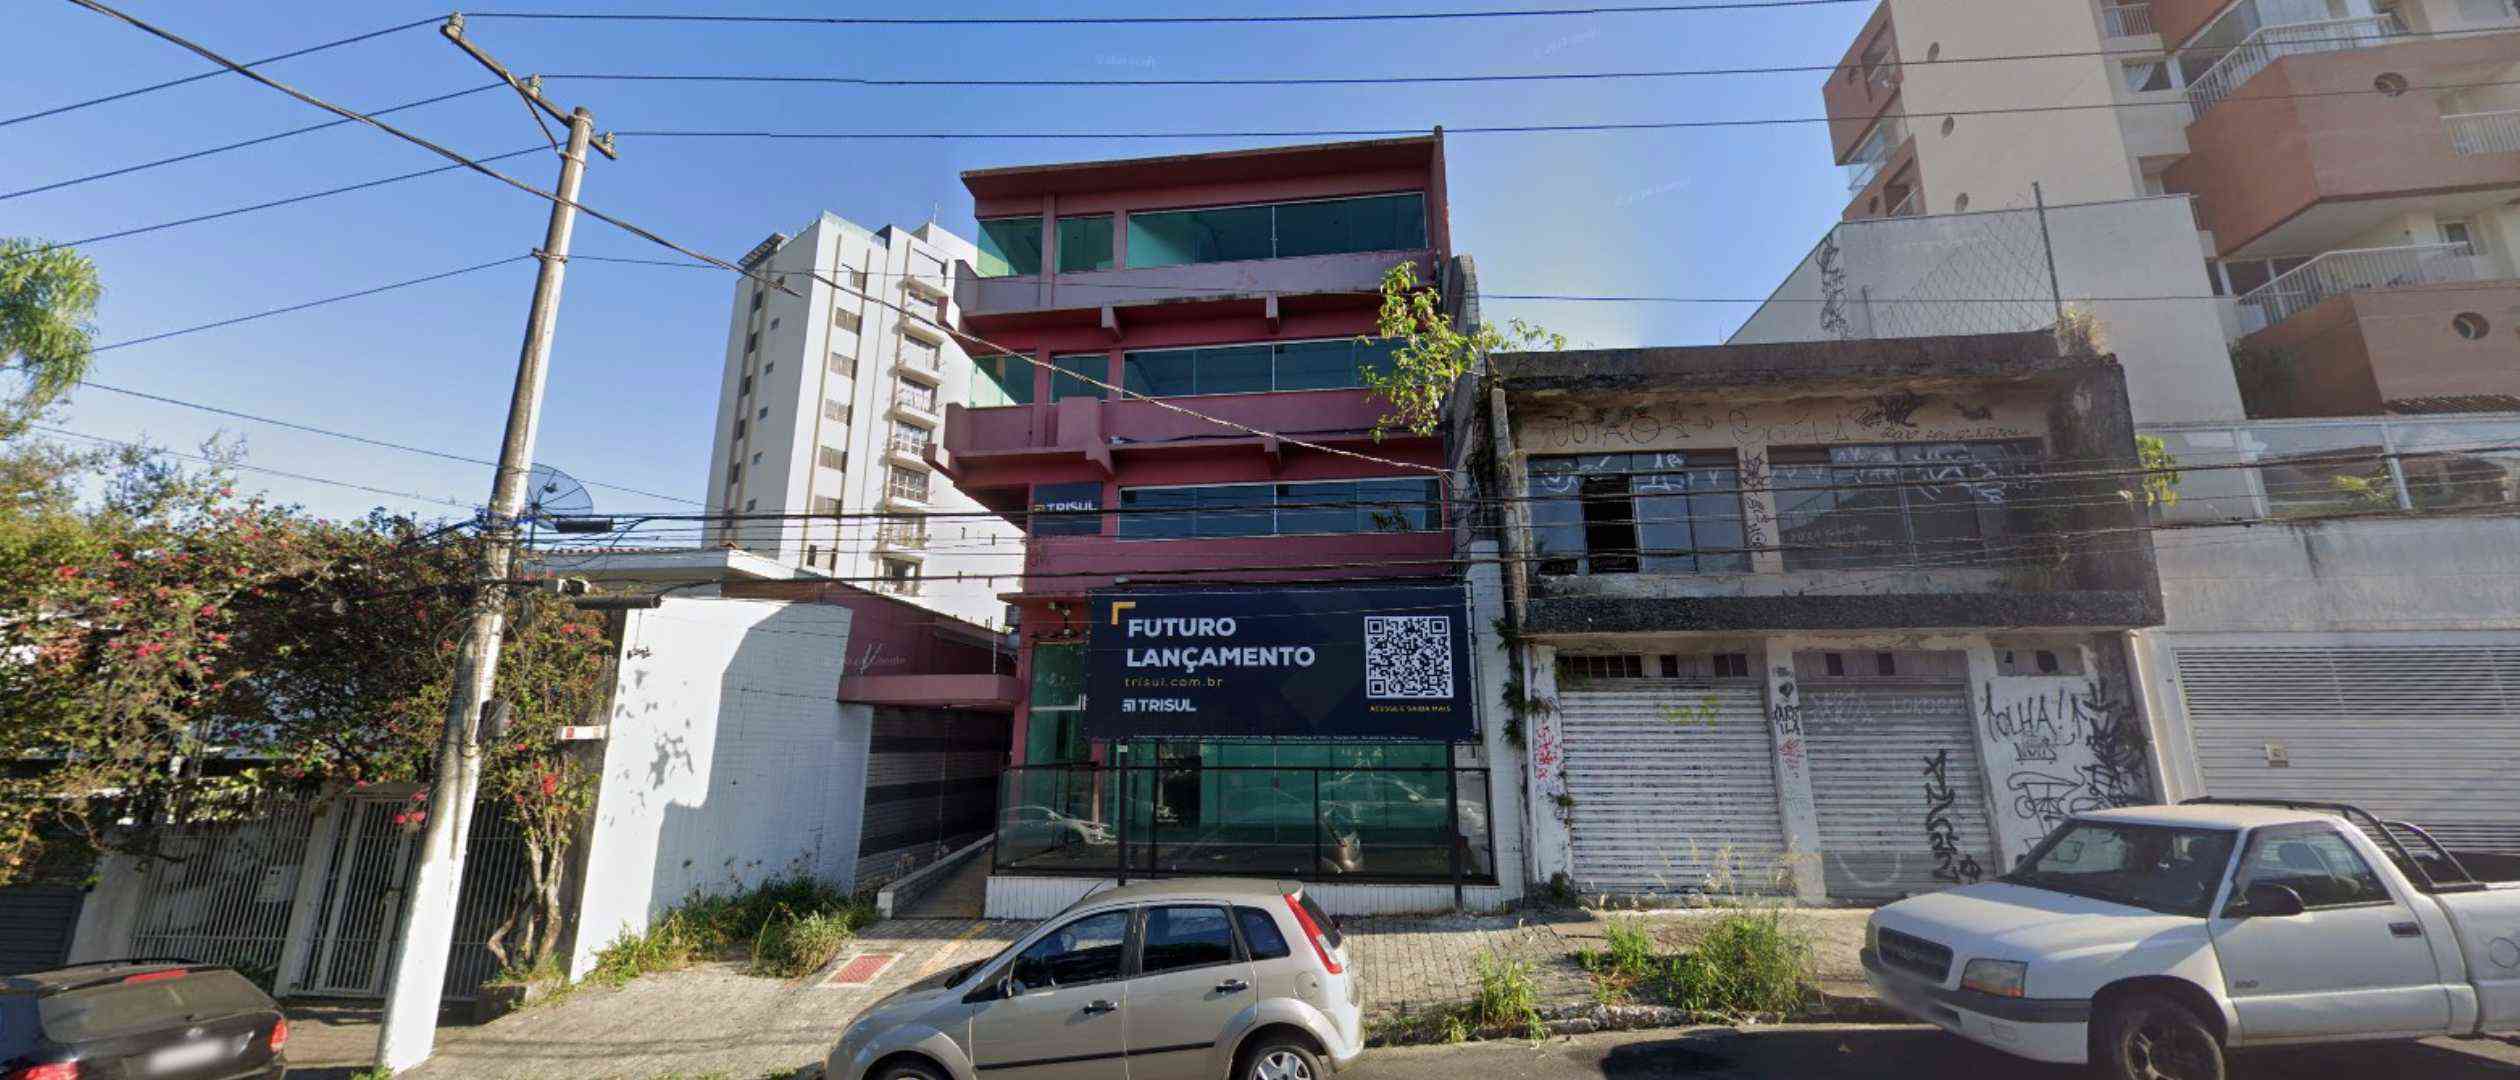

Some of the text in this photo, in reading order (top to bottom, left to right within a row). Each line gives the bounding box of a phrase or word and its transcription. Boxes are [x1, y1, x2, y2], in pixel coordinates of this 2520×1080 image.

[1128, 617, 1236, 638] FUTURO
[1126, 646, 1316, 673] LANÇAMENTO
[1124, 676, 1224, 688] trisul.com.br
[1138, 698, 1197, 713] TRISUL
